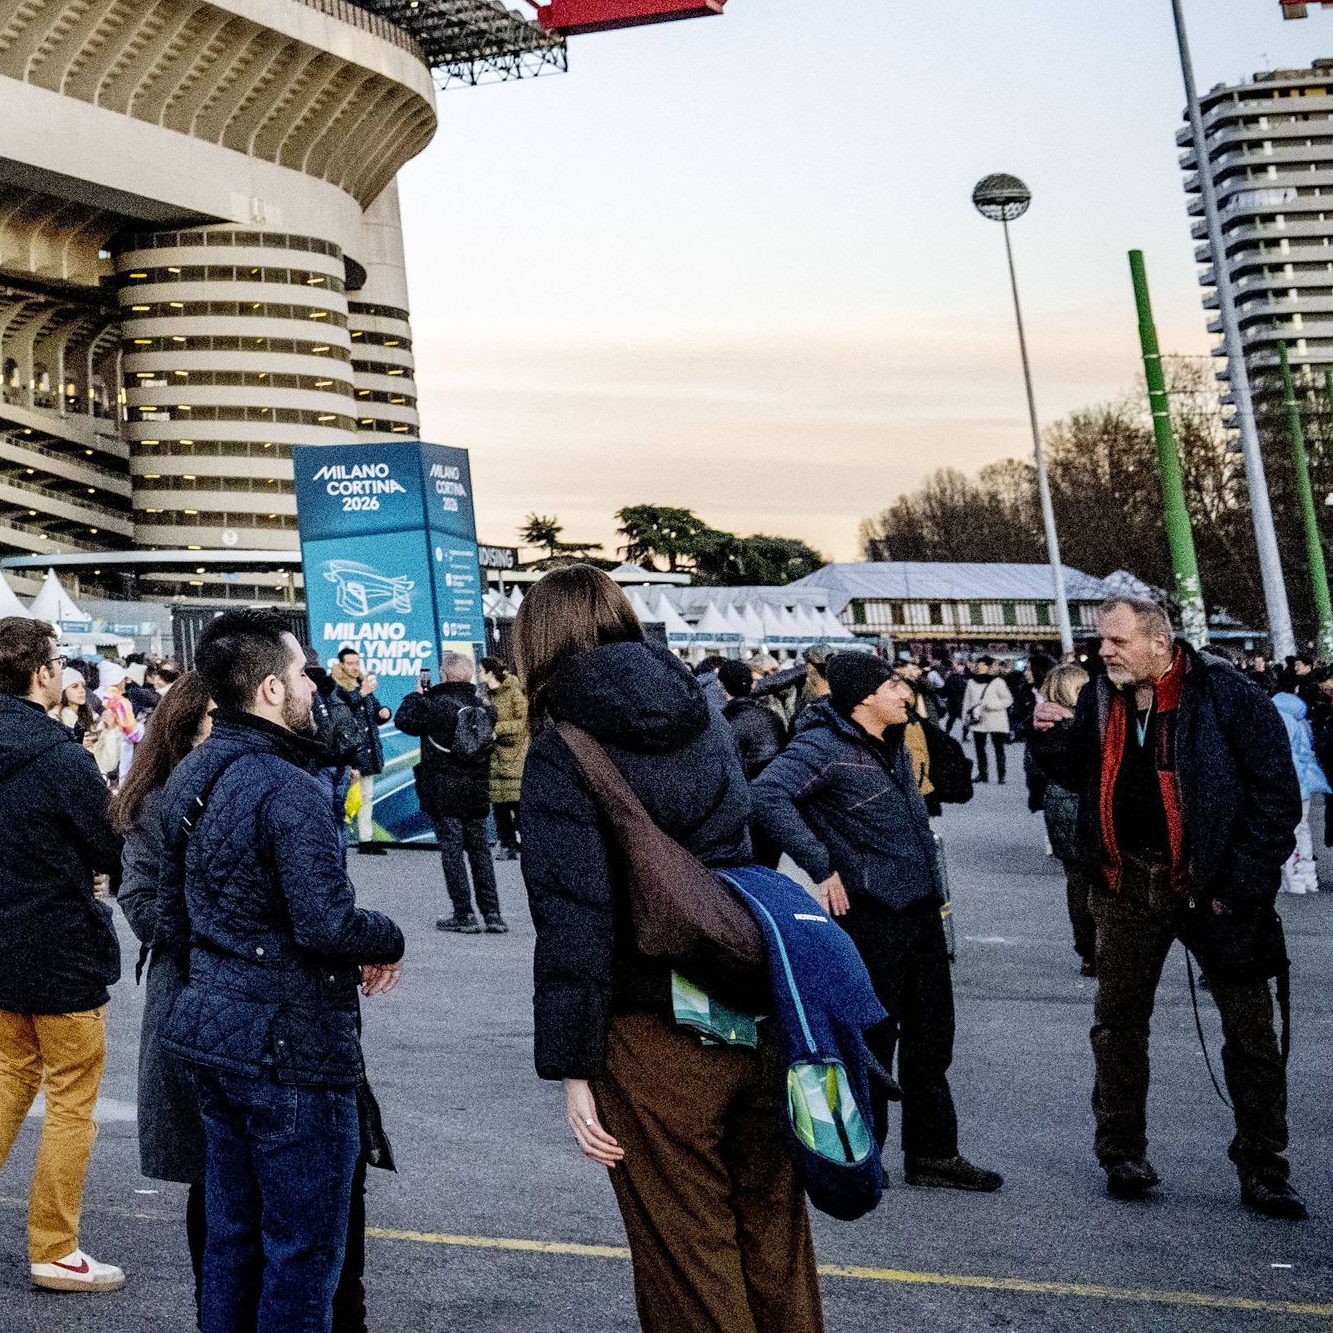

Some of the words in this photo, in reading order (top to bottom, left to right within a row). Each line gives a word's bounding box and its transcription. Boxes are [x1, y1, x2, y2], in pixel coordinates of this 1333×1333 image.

[312, 463, 390, 481] MILANO
[429, 463, 460, 481] MILANO
[326, 479, 407, 496] CORTINA
[342, 496, 380, 512] 2026
[323, 622, 406, 640] MILANO
[326, 657, 422, 677] SADIUM
